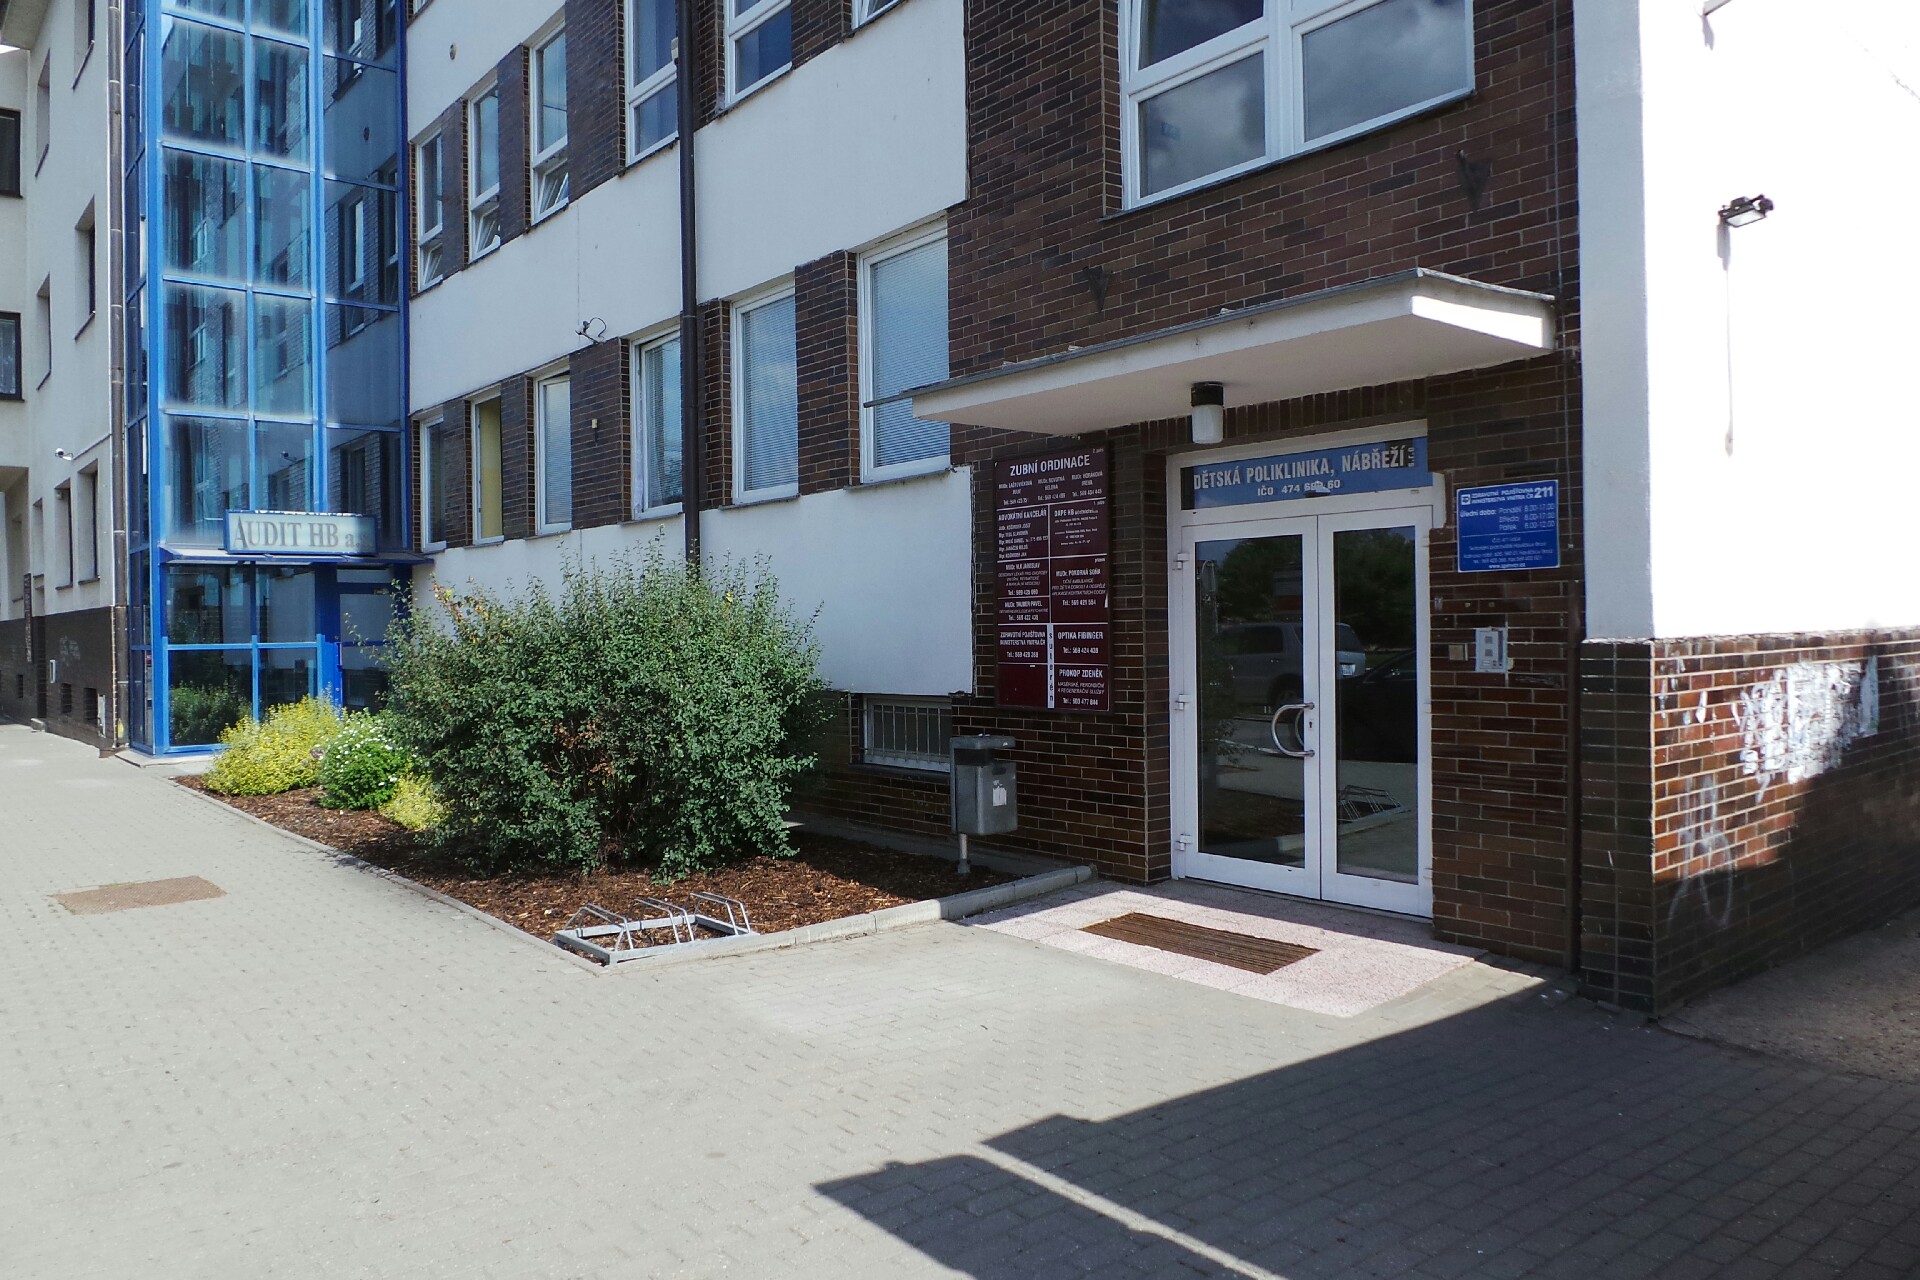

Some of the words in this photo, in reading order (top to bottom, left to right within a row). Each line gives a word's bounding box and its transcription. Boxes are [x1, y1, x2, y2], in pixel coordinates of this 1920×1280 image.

[1010, 460, 1038, 476] ZUBNÍ
[1040, 454, 1090, 472] ORDINACE
[1193, 465, 1241, 490] DĚTSKÁ
[1246, 457, 1335, 483] POLIKLINIKA,
[1341, 445, 1406, 472] NÁBŘEŽÍ
[1281, 484, 1300, 494] 474
[1534, 486, 1554, 498] 211
[1024, 508, 1046, 518] KANCELÁŘ
[234, 516, 302, 550] AUDIT
[308, 522, 338, 548] HB
[1068, 568, 1088, 576] POKORNÁ
[1058, 632, 1076, 640] OPTIKA
[1078, 632, 1104, 640] FIBINGER
[1059, 669, 1080, 678] PROKOP
[1082, 668, 1103, 678] ZDENĚK
